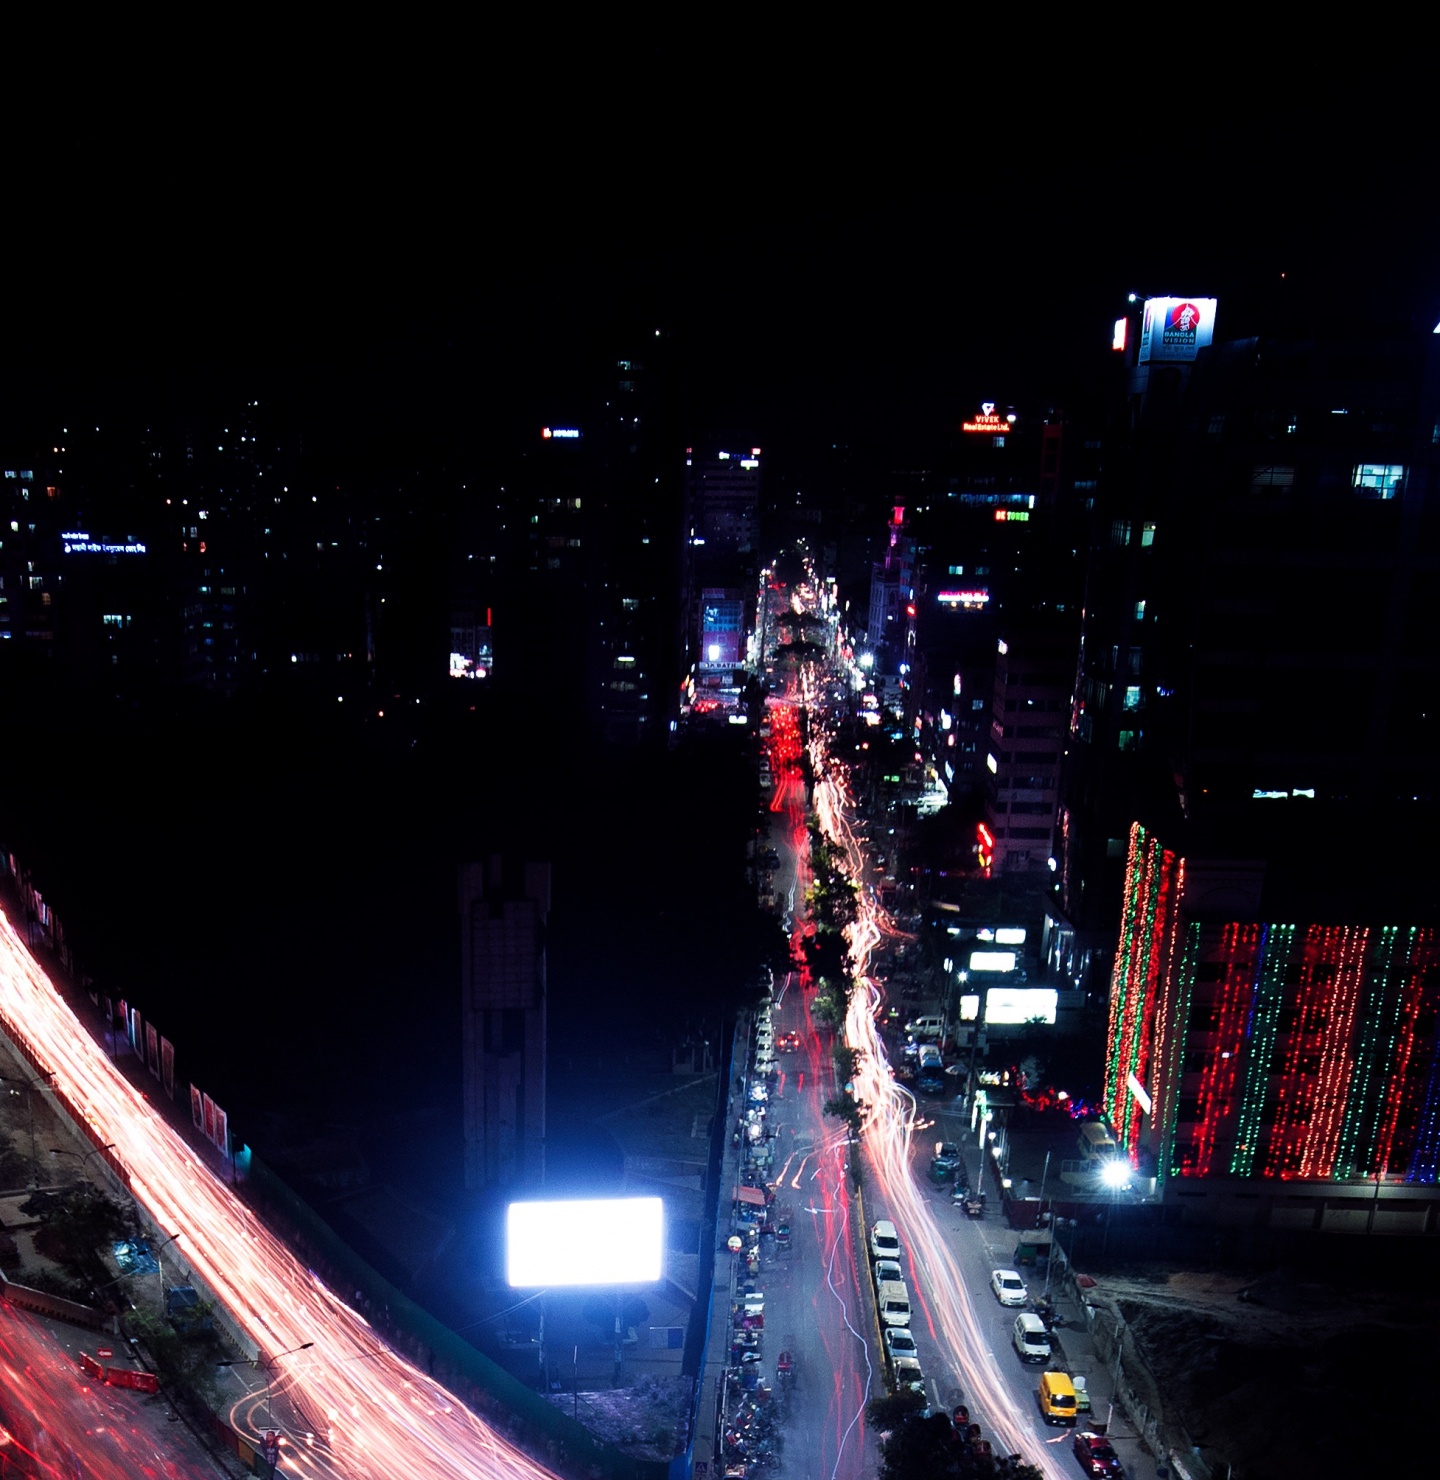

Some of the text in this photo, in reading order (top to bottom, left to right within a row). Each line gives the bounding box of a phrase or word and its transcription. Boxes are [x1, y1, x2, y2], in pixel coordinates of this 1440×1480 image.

[975, 415, 999, 423] VIVEK
[963, 423, 1010, 431] Real Estate Ltd.
[1006, 511, 1029, 521] TOWER
